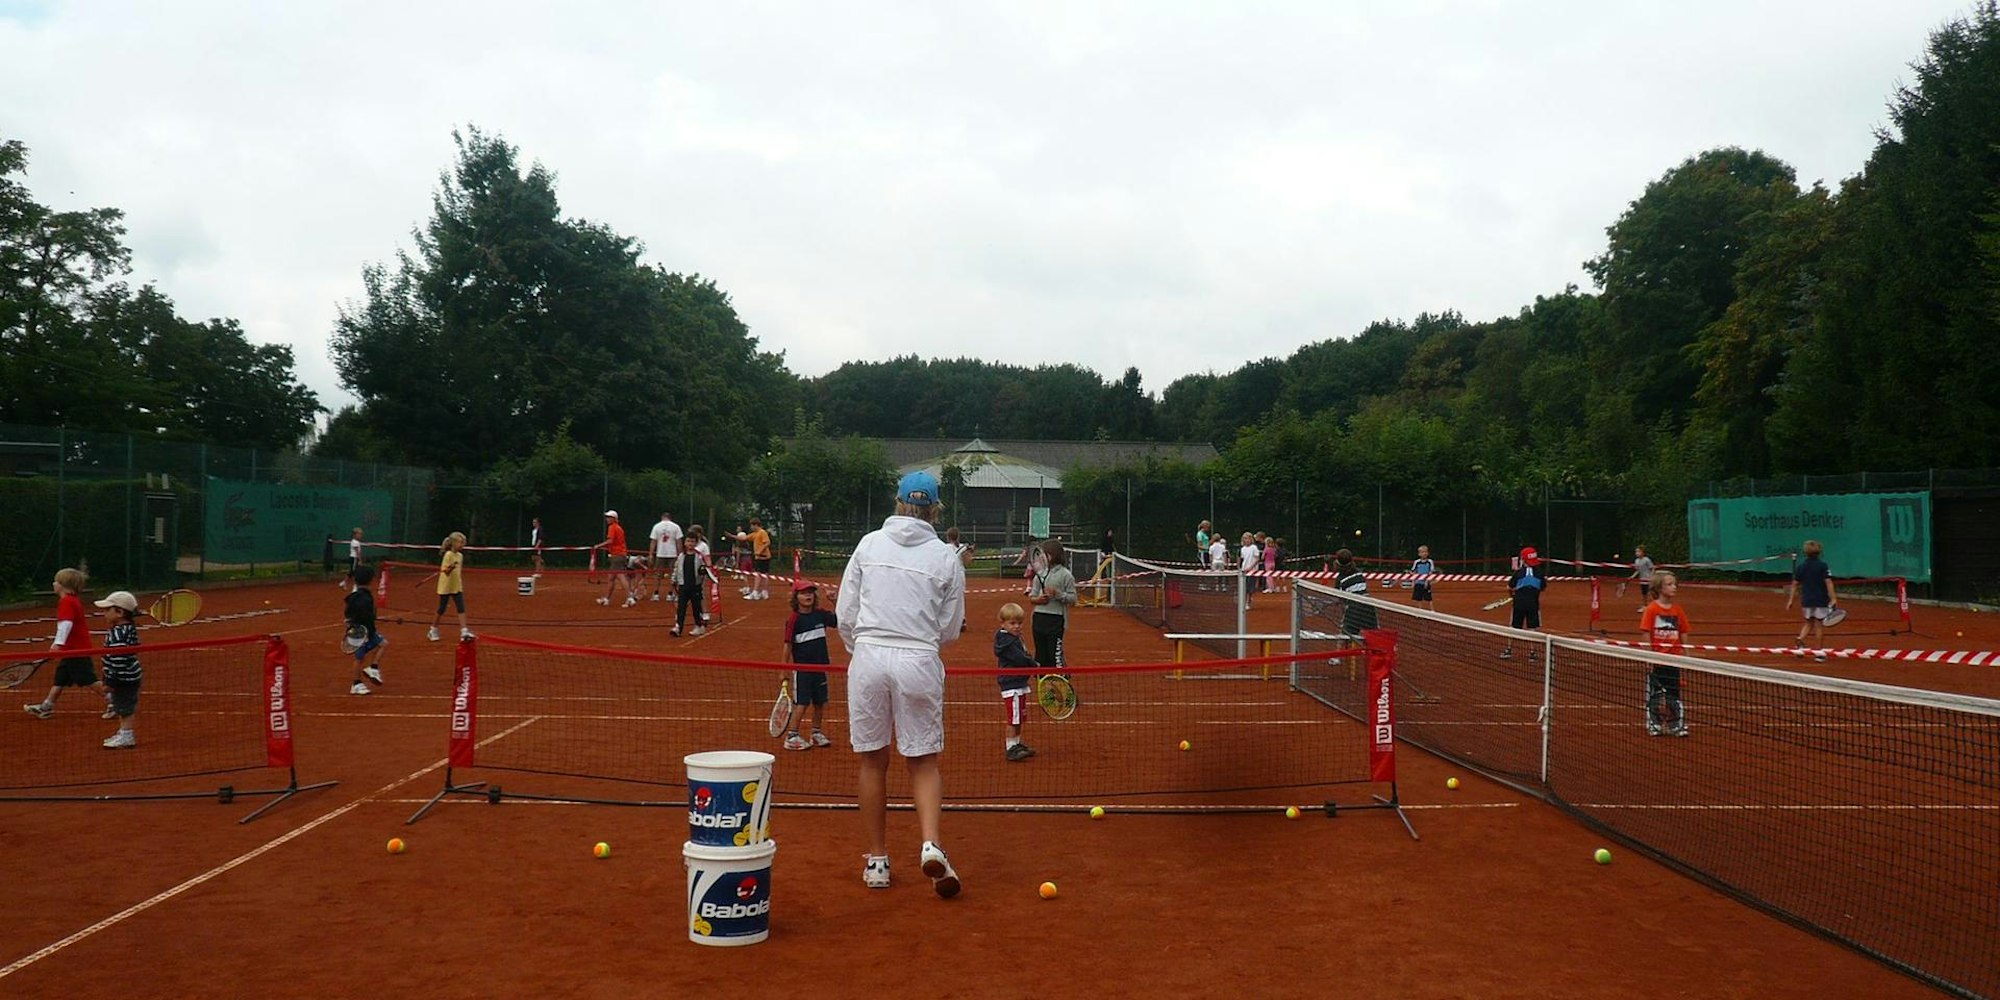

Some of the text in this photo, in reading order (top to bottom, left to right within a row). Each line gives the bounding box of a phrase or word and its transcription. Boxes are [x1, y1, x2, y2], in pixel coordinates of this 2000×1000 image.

[1745, 510, 1845, 532] Sporthaus Denker
[271, 666, 284, 710] Wilson
[455, 667, 470, 711] Wilson
[1377, 678, 1390, 723] Wilson
[702, 900, 769, 919] Babola
